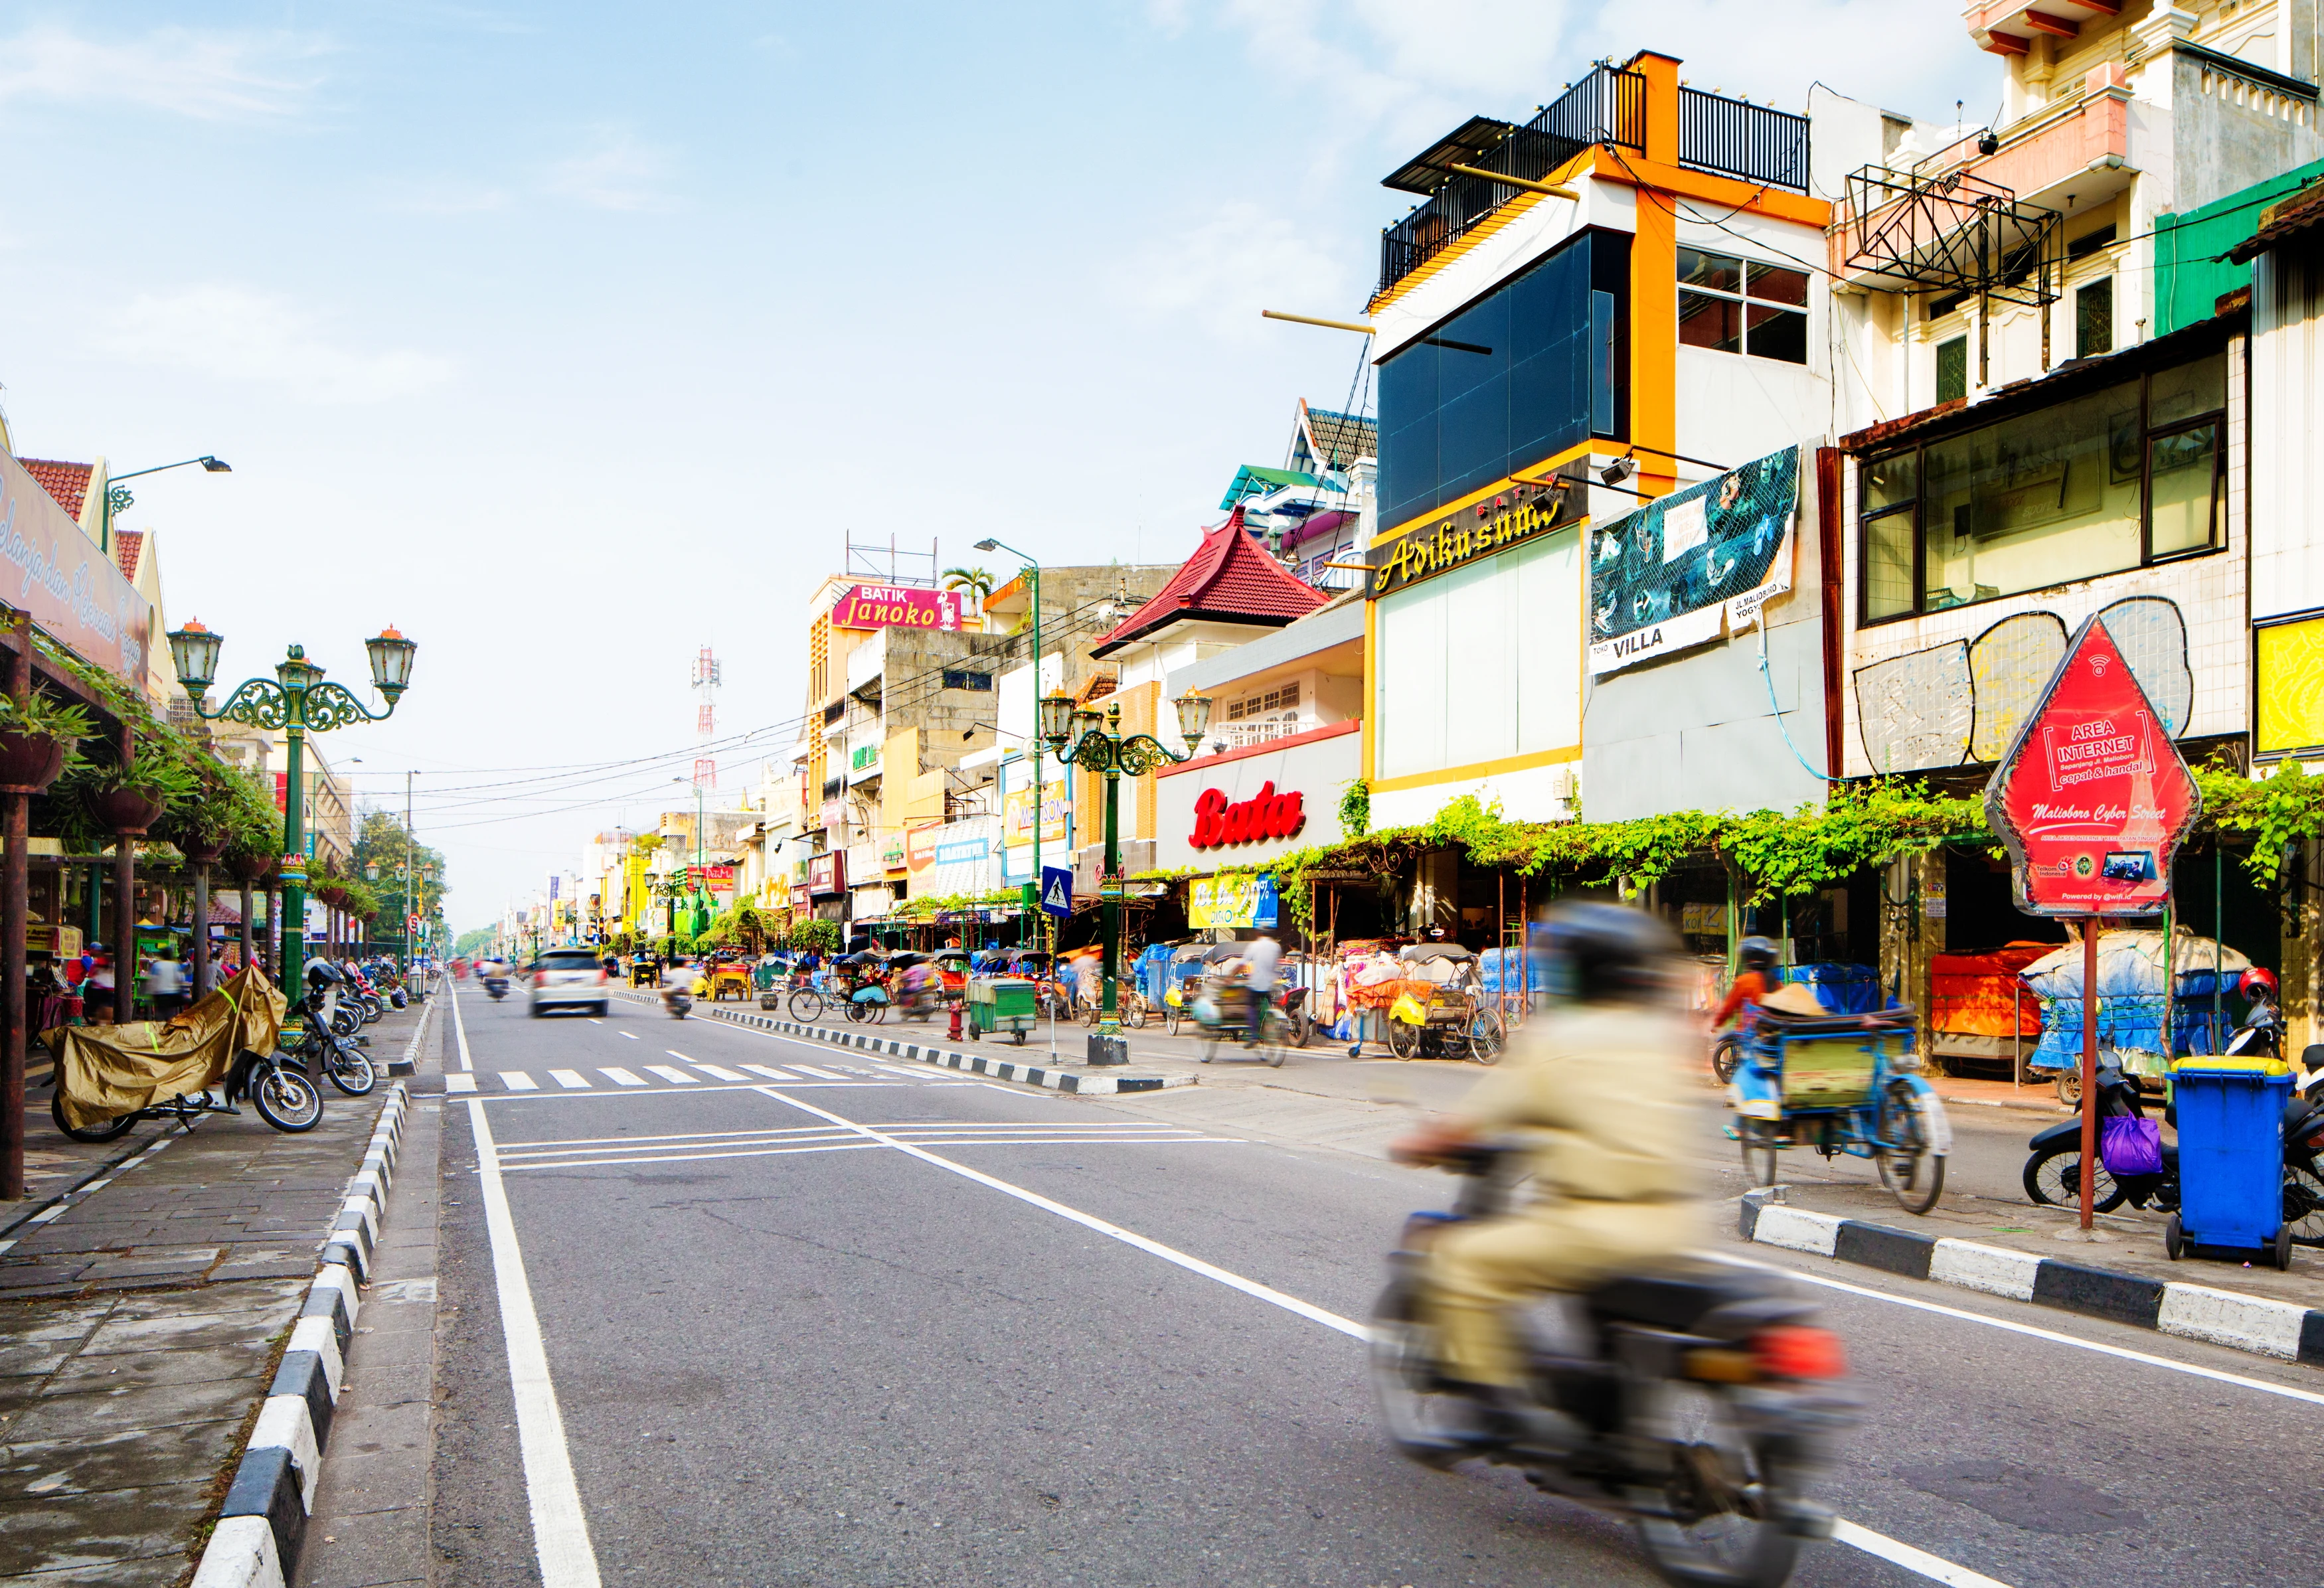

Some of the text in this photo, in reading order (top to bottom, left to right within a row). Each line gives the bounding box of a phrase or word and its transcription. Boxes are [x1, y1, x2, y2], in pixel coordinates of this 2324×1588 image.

[0, 474, 140, 678] elanja dan Rekreasi Yogya
[861, 587, 907, 603] BATIK
[842, 597, 935, 626] Janoko
[1736, 604, 1760, 619] YOGY
[1593, 628, 1663, 659] TOKO VILLA
[2072, 720, 2116, 741] AREA
[2057, 736, 2135, 763] INTERNET
[2059, 761, 2143, 785] cepat & handal
[2060, 759, 2093, 771] Sepanjang
[2104, 754, 2135, 763] Malioboro
[1021, 798, 1062, 827] MAISON
[1189, 780, 1306, 848] Bata
[2032, 803, 2166, 822] Malioboro Cyber Street
